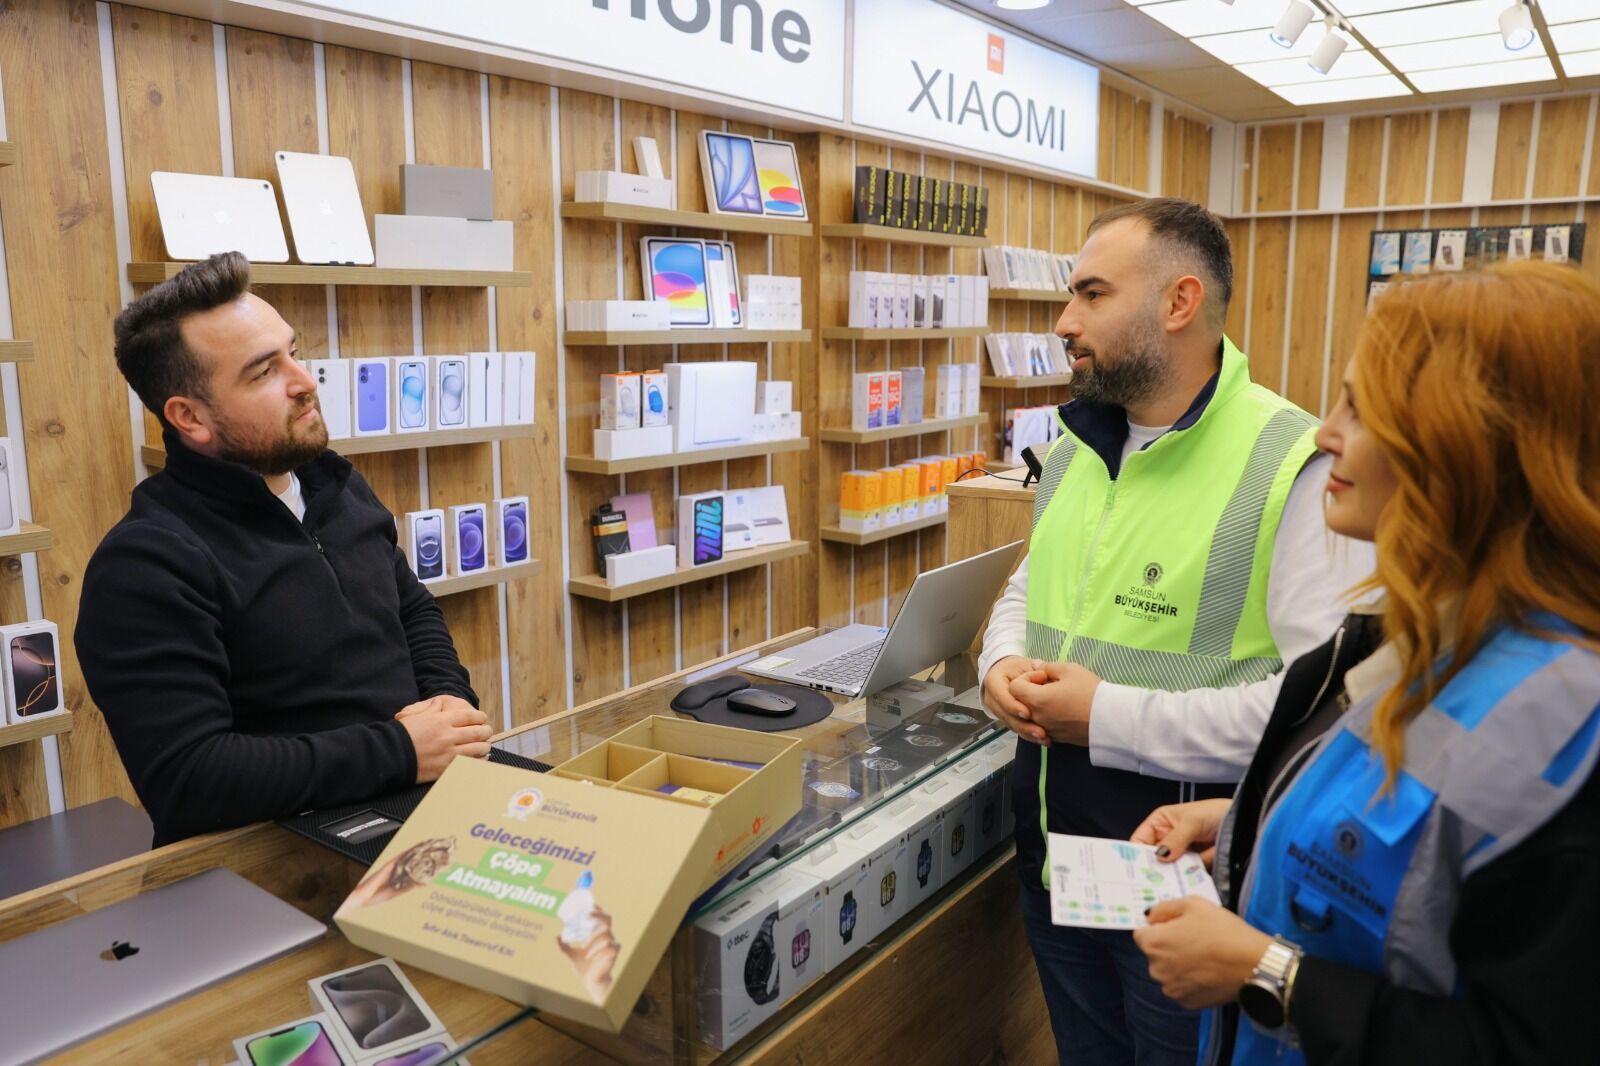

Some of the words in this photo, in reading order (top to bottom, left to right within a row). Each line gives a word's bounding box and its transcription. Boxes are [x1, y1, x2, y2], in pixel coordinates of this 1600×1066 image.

[592, 0, 811, 64] one
[907, 59, 1065, 152] XIAOMI
[869, 166, 877, 194] POCO
[887, 170, 895, 198] POCO
[903, 173, 911, 201] POCO
[1114, 594, 1178, 616] BÜYÜKŞEHİR
[1129, 586, 1167, 602] SAMSUN
[470, 823, 596, 865] Geleceğimizi
[490, 851, 543, 878] Çöpe
[446, 867, 557, 910] Atmayalım
